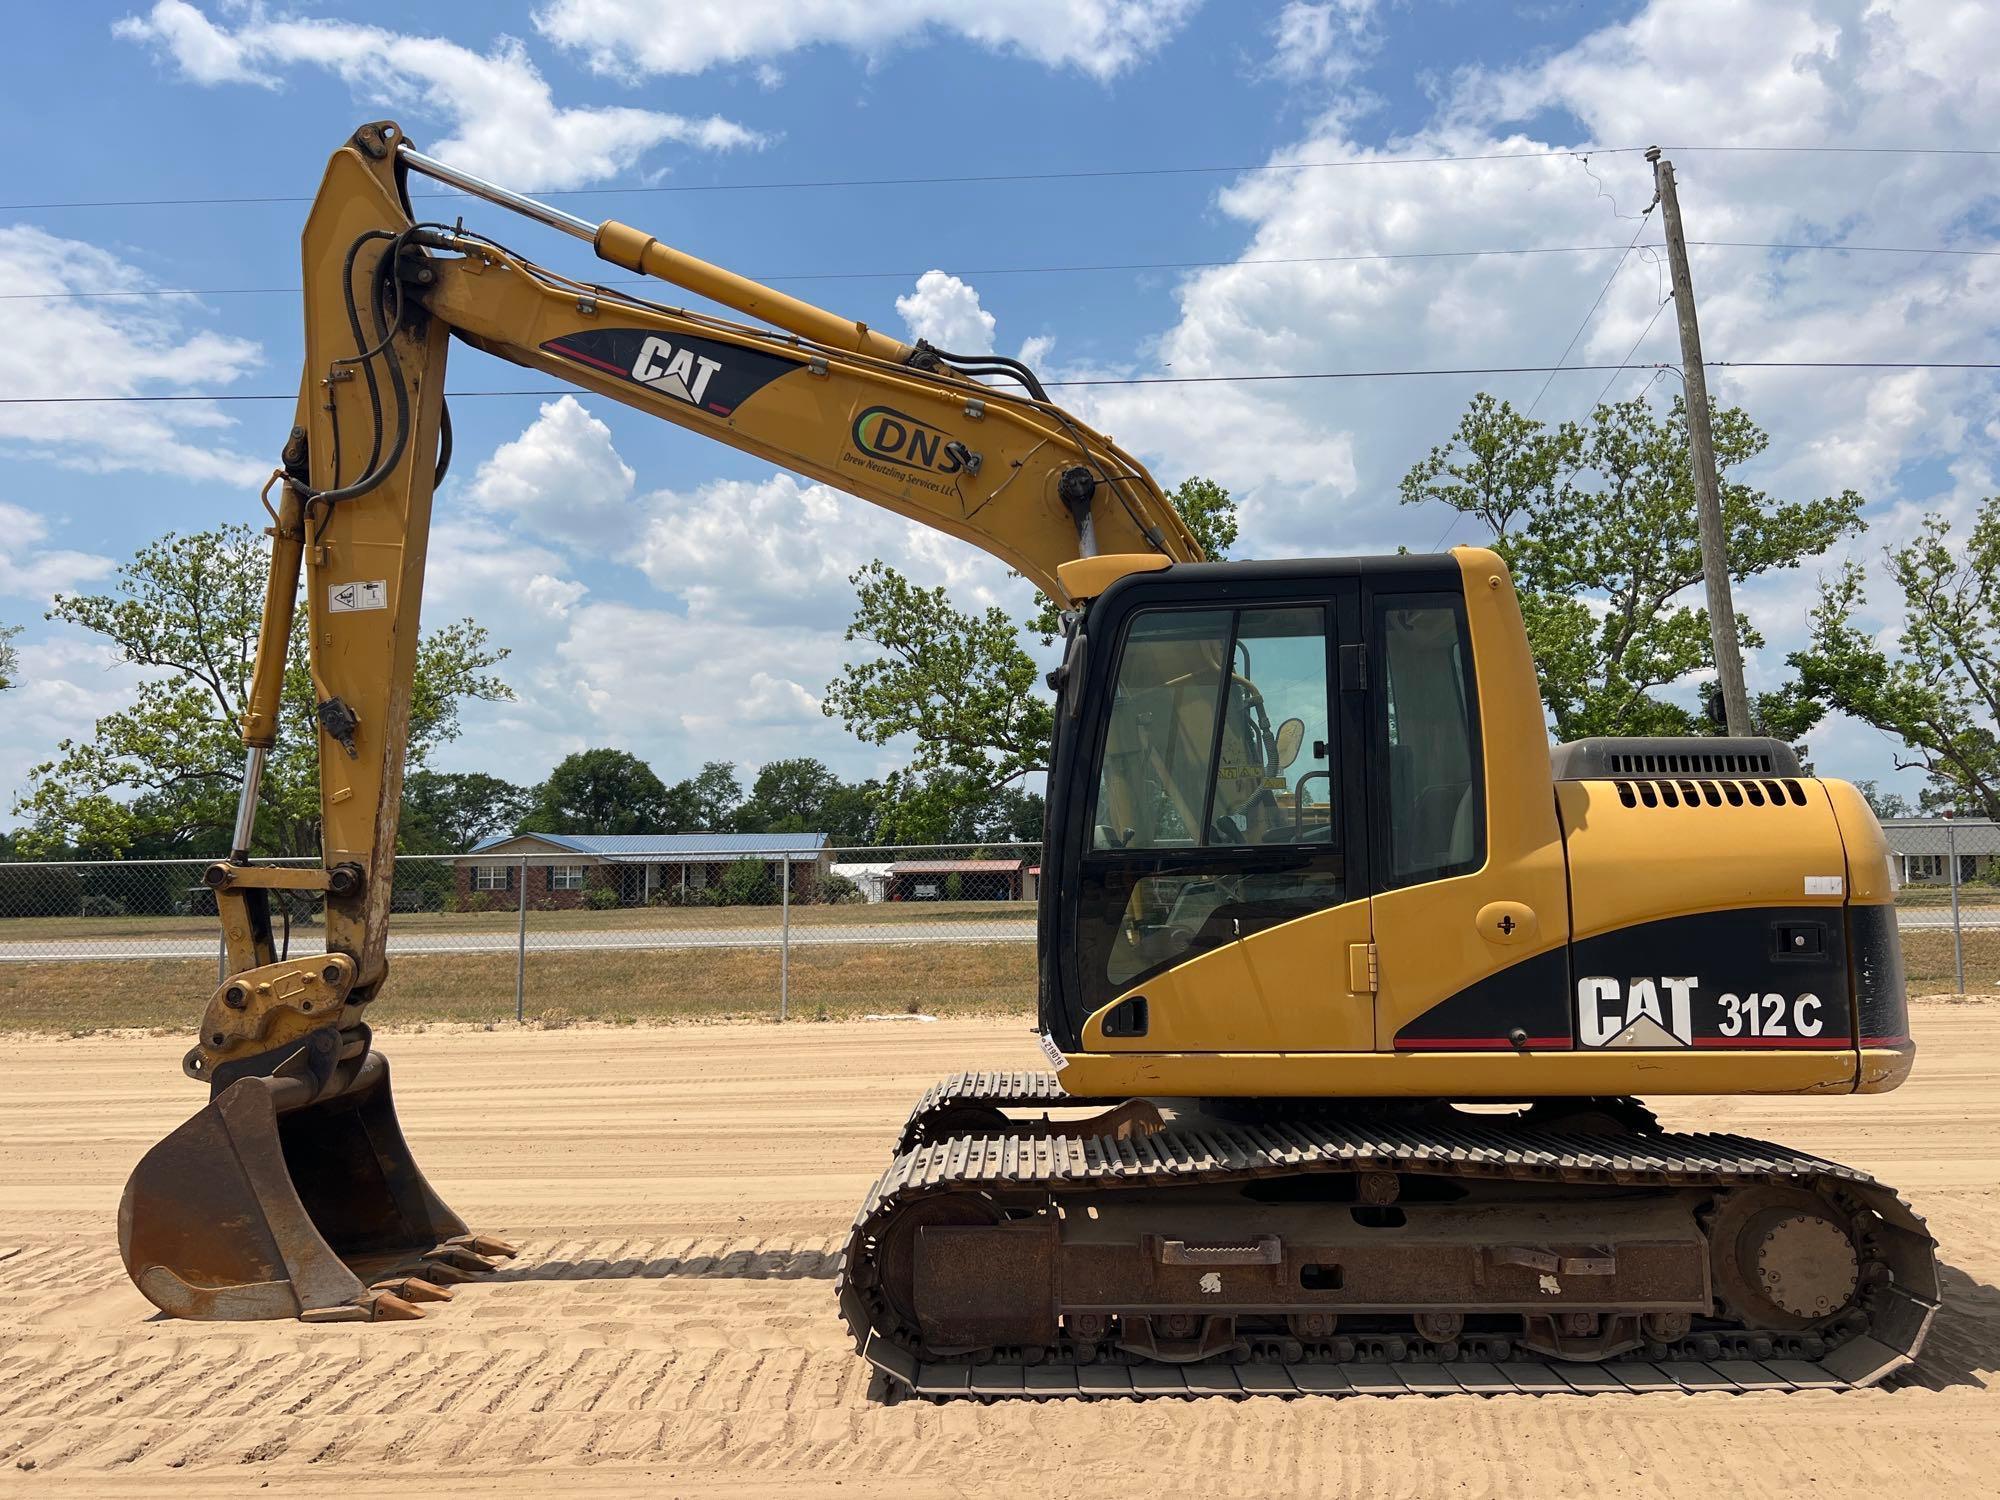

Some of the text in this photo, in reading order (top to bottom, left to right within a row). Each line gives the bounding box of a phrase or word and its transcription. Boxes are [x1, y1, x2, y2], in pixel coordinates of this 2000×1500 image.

[632, 336, 722, 404] CAT
[844, 452, 958, 497] Drew Neutzling Services LLC
[1577, 976, 1699, 1047] CAT
